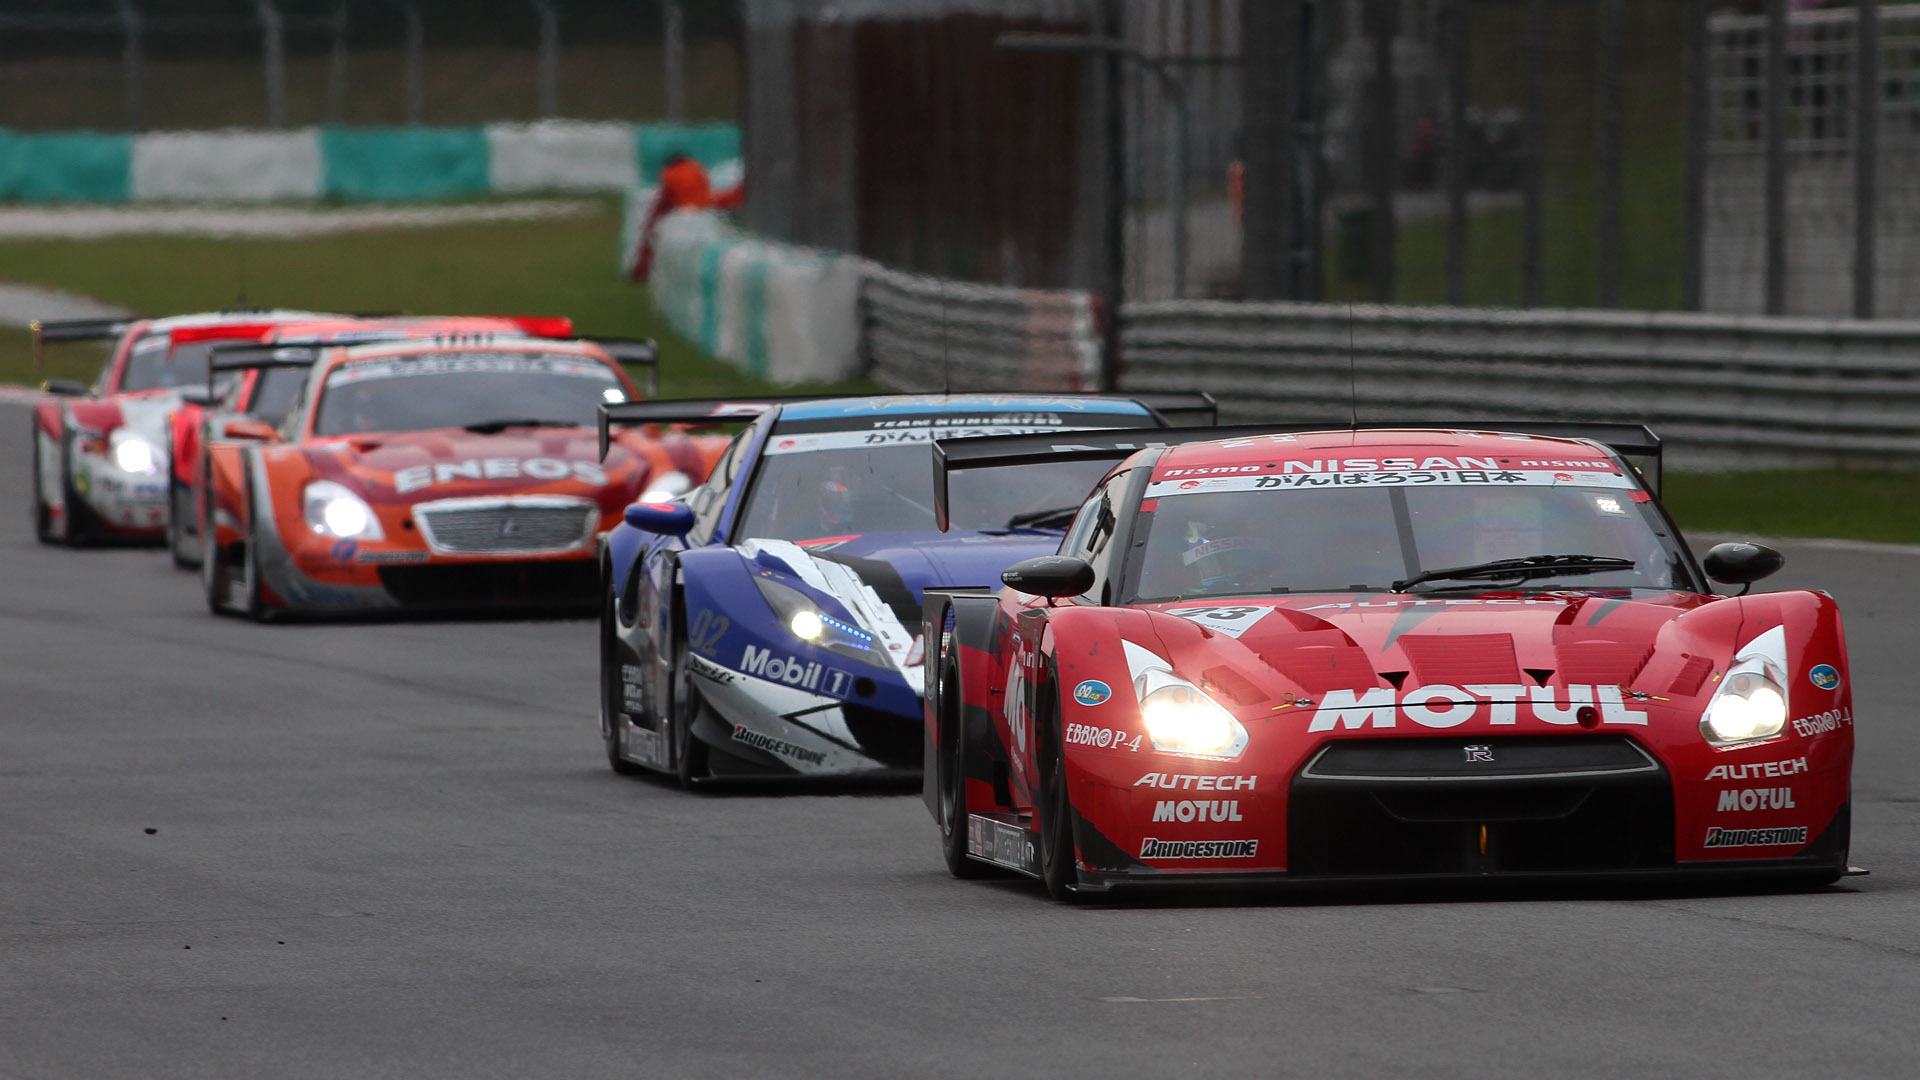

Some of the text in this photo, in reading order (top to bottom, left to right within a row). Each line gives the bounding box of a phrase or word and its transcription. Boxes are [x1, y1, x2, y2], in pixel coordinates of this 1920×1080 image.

[873, 418, 931, 428] TEAM
[393, 457, 610, 494] ENEOS
[1164, 465, 1261, 477] nismo
[1283, 456, 1500, 474] NISSAN
[1521, 460, 1610, 468] nismo
[1255, 471, 1527, 488] がんばろう!日本
[690, 608, 729, 657] 02
[739, 645, 823, 689] Mobil
[1308, 684, 1648, 733] MOTUL
[732, 725, 827, 766] BRIDGESTONE
[1066, 723, 1143, 752] EBBRO P-4
[1704, 757, 1809, 780] AUTECH
[1134, 772, 1257, 791] AUTECH
[1717, 787, 1796, 812] MOTUL
[1152, 800, 1243, 823] MOTUL
[1140, 838, 1259, 859] BRIDGESTONE
[1704, 826, 1808, 848] BRIDGESTONE
